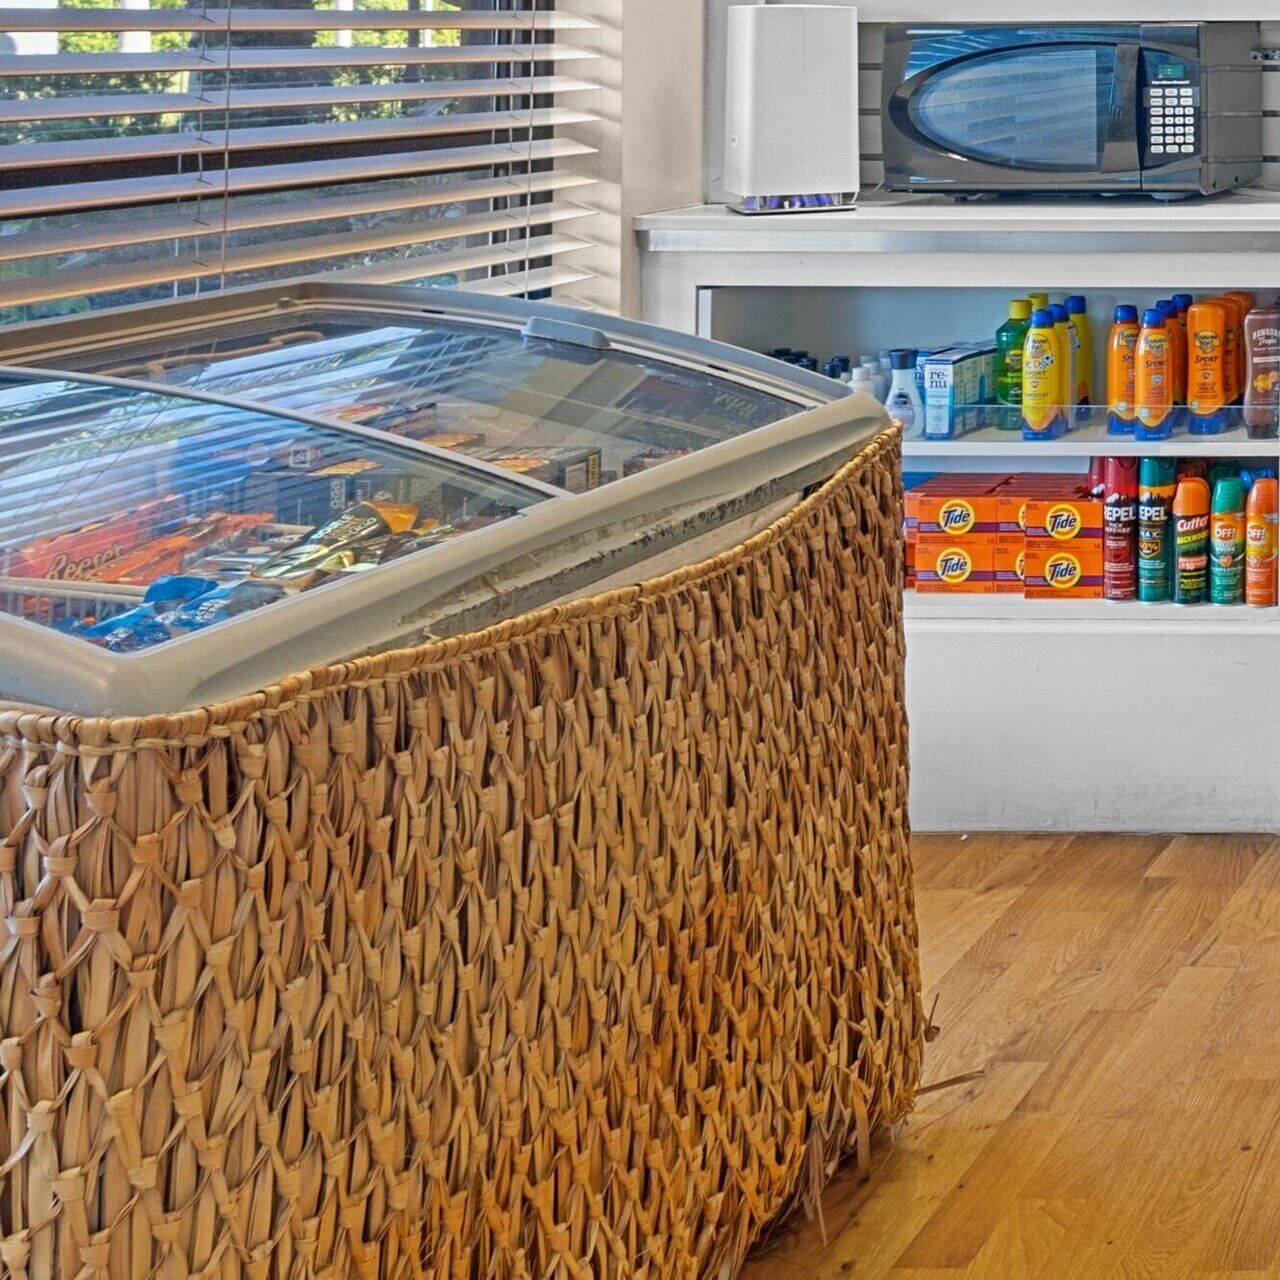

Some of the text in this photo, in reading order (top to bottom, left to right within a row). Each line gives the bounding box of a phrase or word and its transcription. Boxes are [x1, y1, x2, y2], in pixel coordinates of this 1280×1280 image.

[1146, 360, 1168, 368] SPORT
[1195, 355, 1220, 363] SPORT
[930, 380, 947, 388] nu
[943, 508, 971, 528] Tide
[1139, 505, 1169, 521] EPEL
[1049, 513, 1077, 532] Tide
[1177, 517, 1210, 532] Cutter
[1215, 526, 1238, 539] OFF!
[1248, 527, 1266, 539] OFF!
[940, 556, 968, 576] Tide
[1049, 562, 1077, 582] Tide
